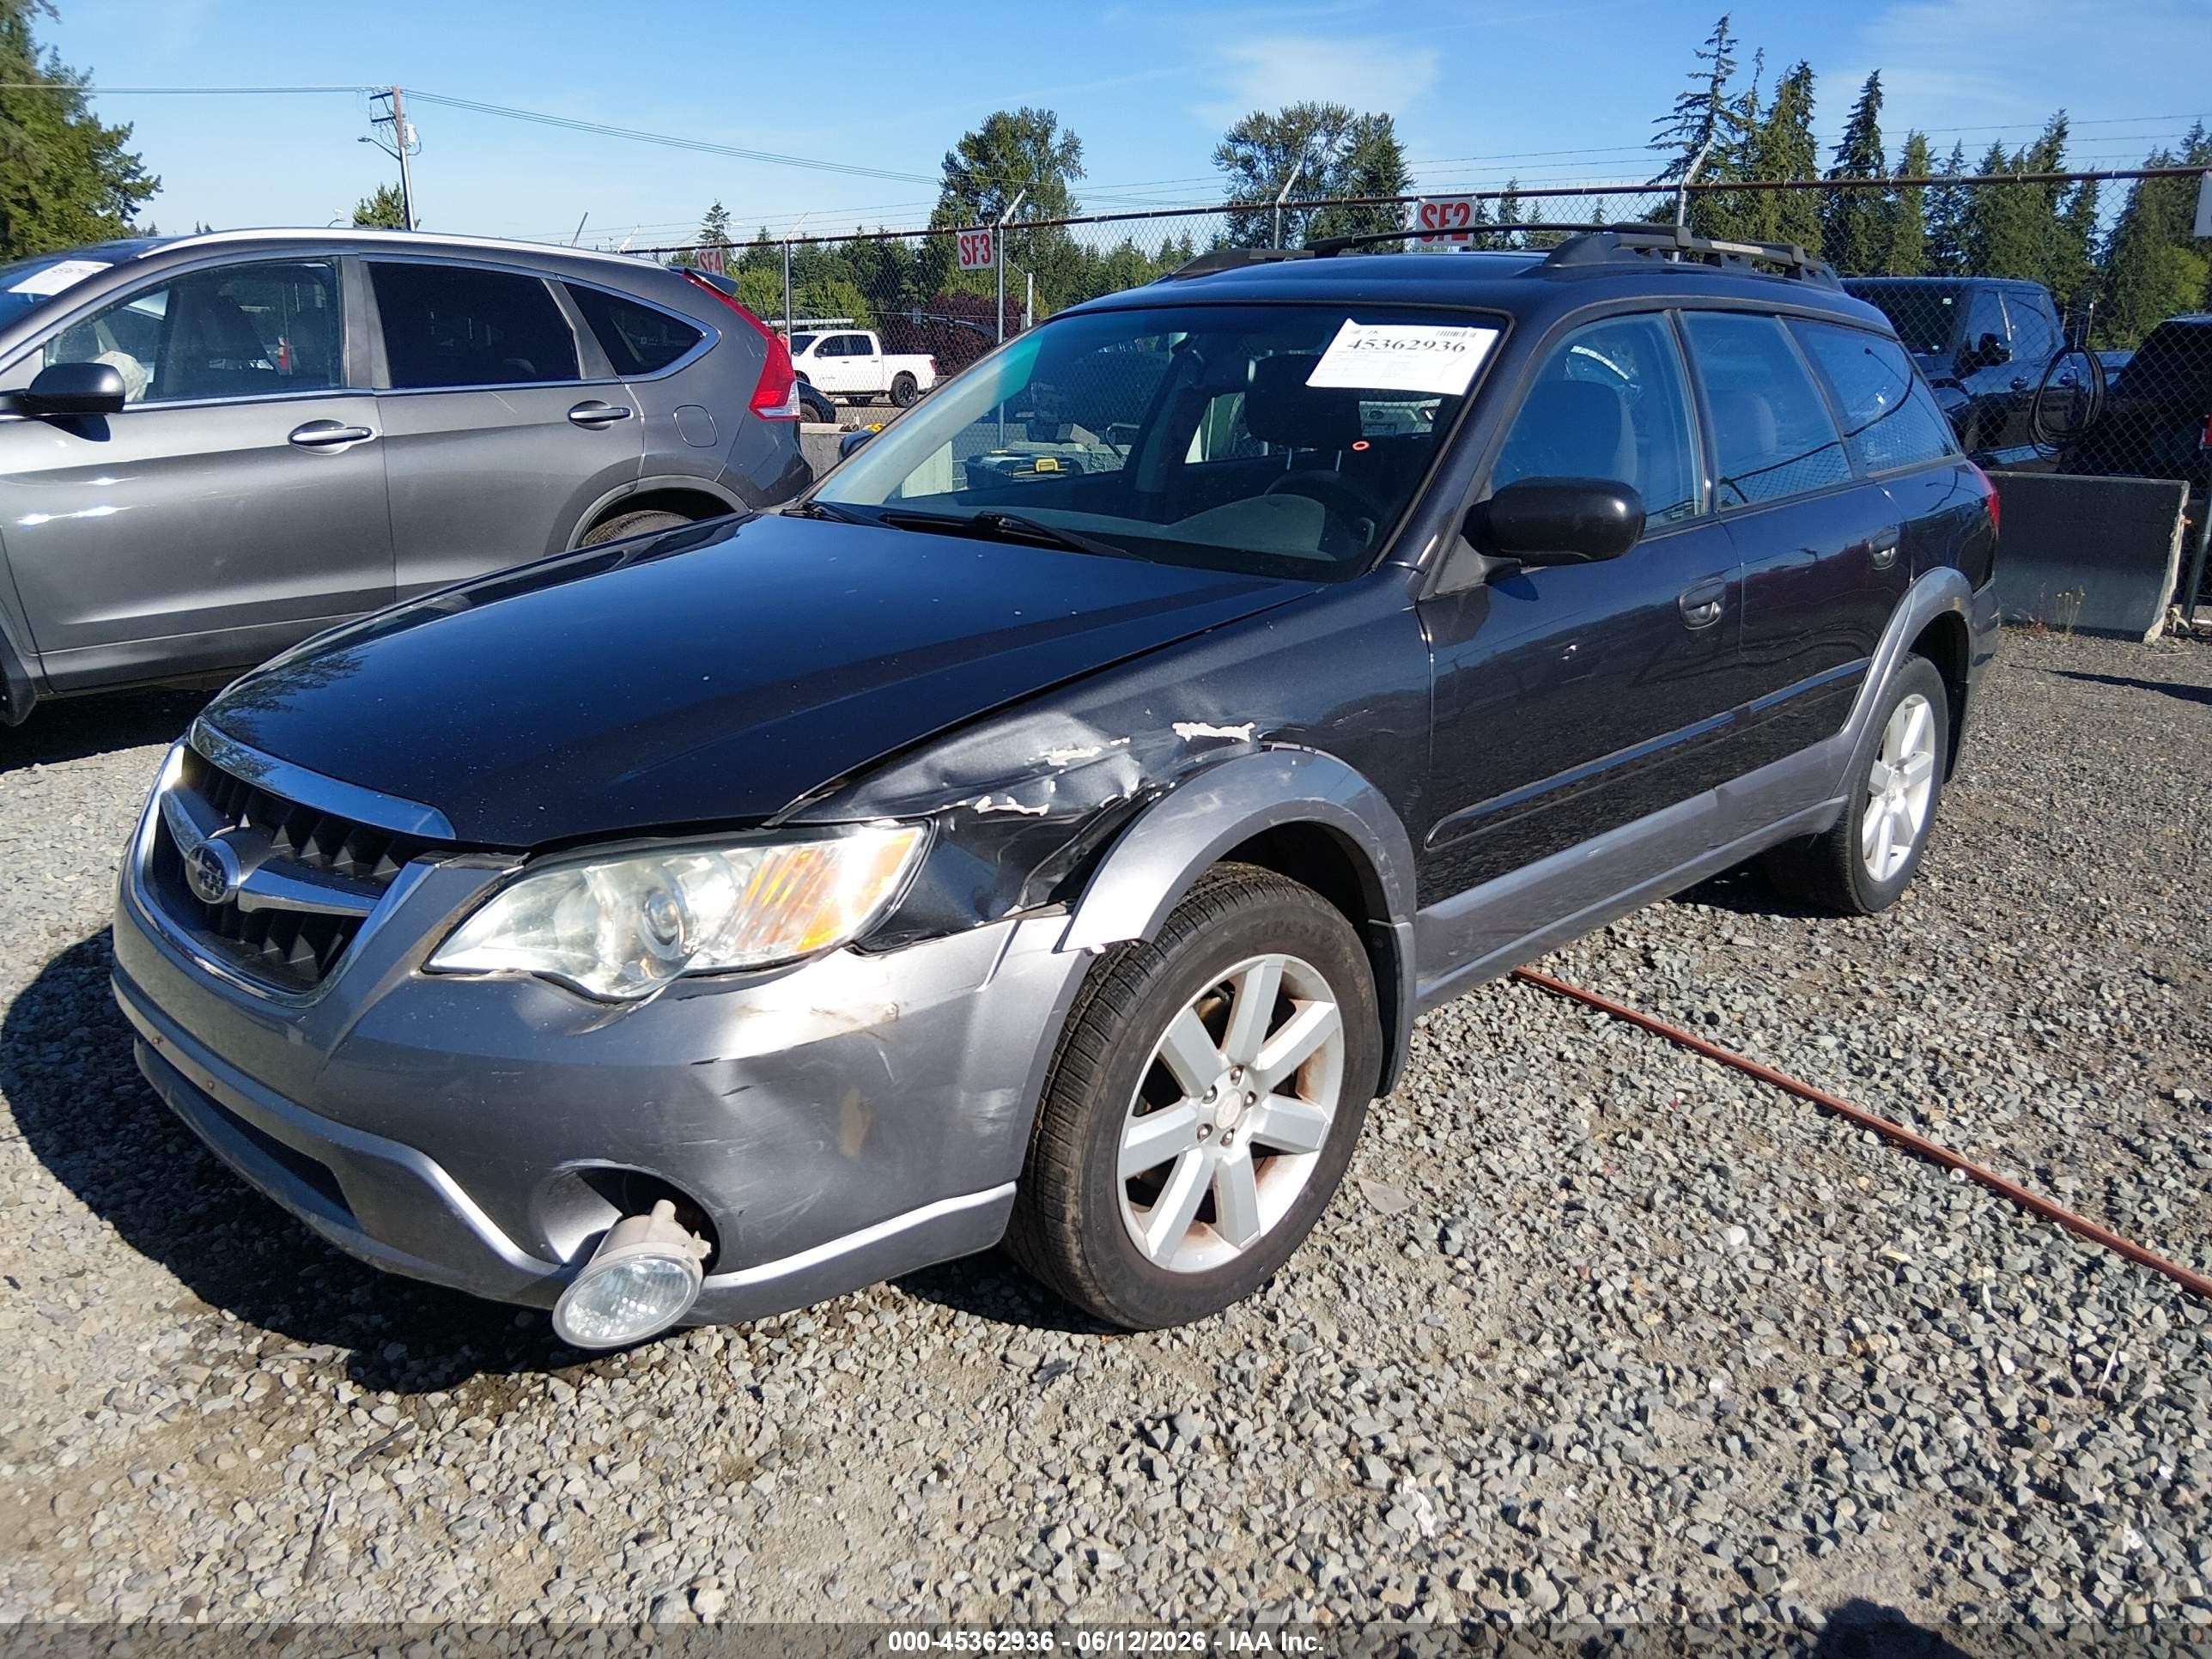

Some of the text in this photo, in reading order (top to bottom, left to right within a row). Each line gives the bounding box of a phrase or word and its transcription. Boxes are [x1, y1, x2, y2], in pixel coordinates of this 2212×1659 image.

[1420, 201, 1471, 243] SF2
[699, 251, 723, 276] SF4
[960, 233, 991, 266] SF3
[1346, 338, 1467, 354] 45362936
